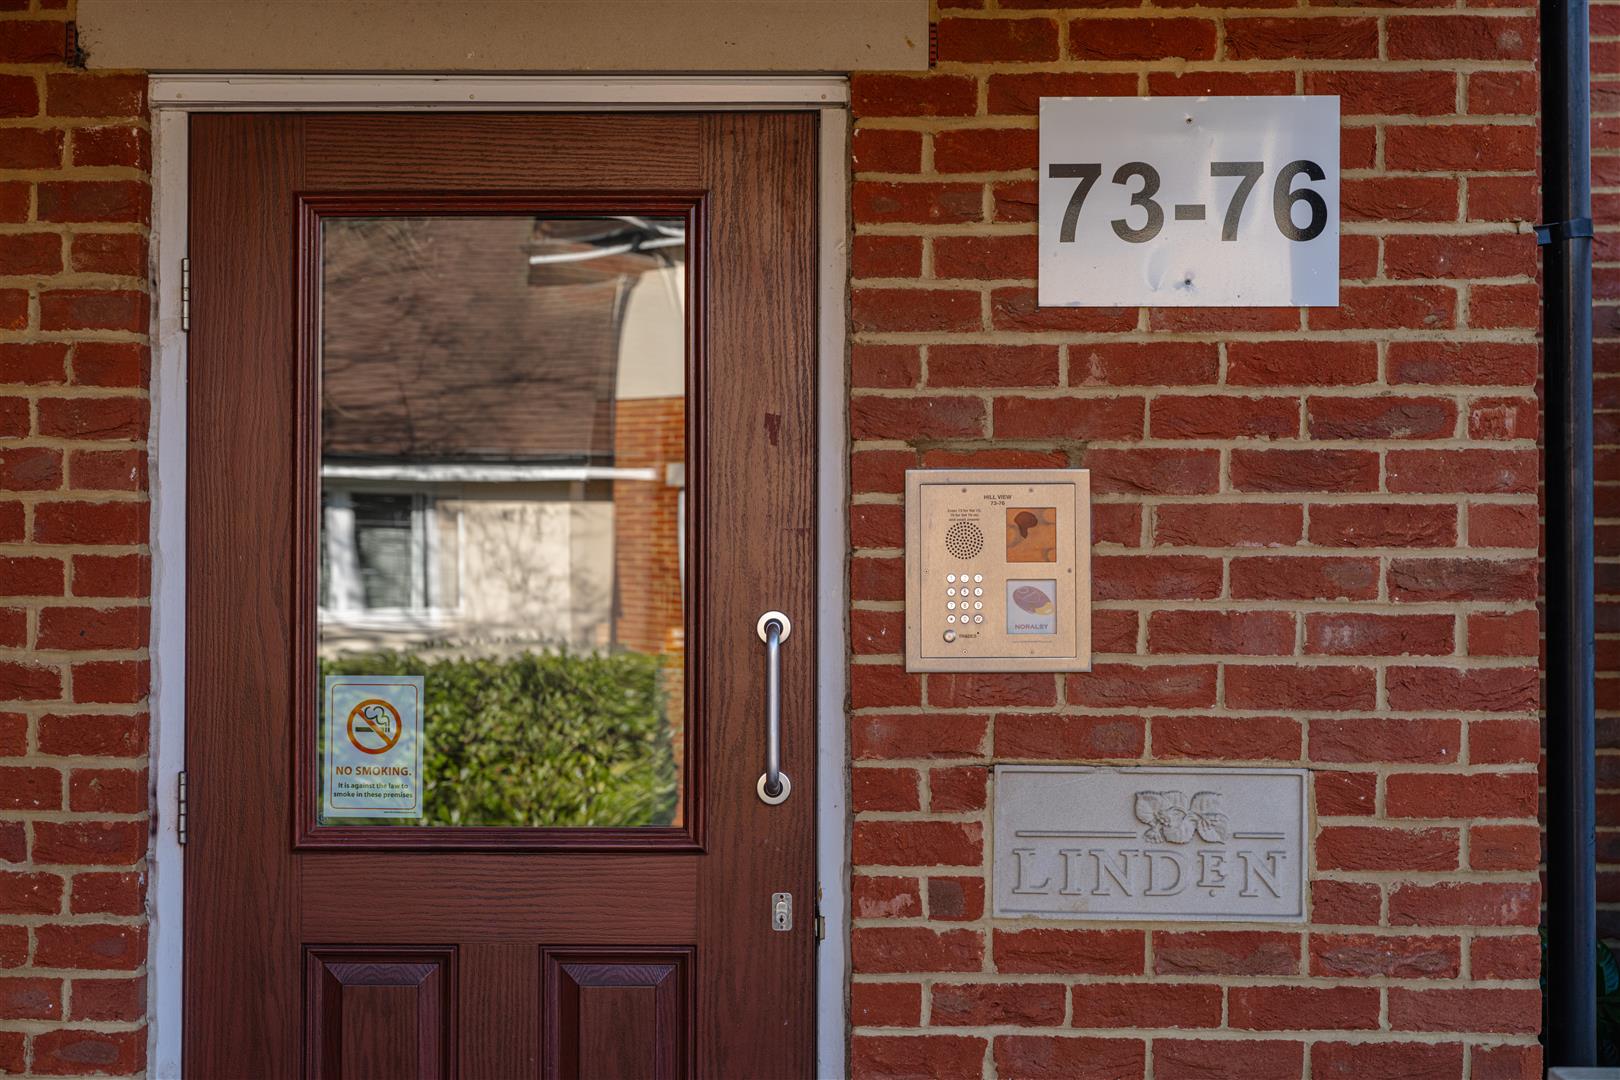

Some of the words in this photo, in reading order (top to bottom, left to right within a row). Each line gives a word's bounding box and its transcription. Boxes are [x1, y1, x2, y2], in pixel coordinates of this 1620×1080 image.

[1048, 159, 1328, 244] 73-76
[335, 766, 352, 775] NO
[355, 766, 412, 776] SMOKING.
[351, 782, 375, 790] against
[383, 791, 413, 799] premises
[1011, 847, 1287, 898] LINDEN
